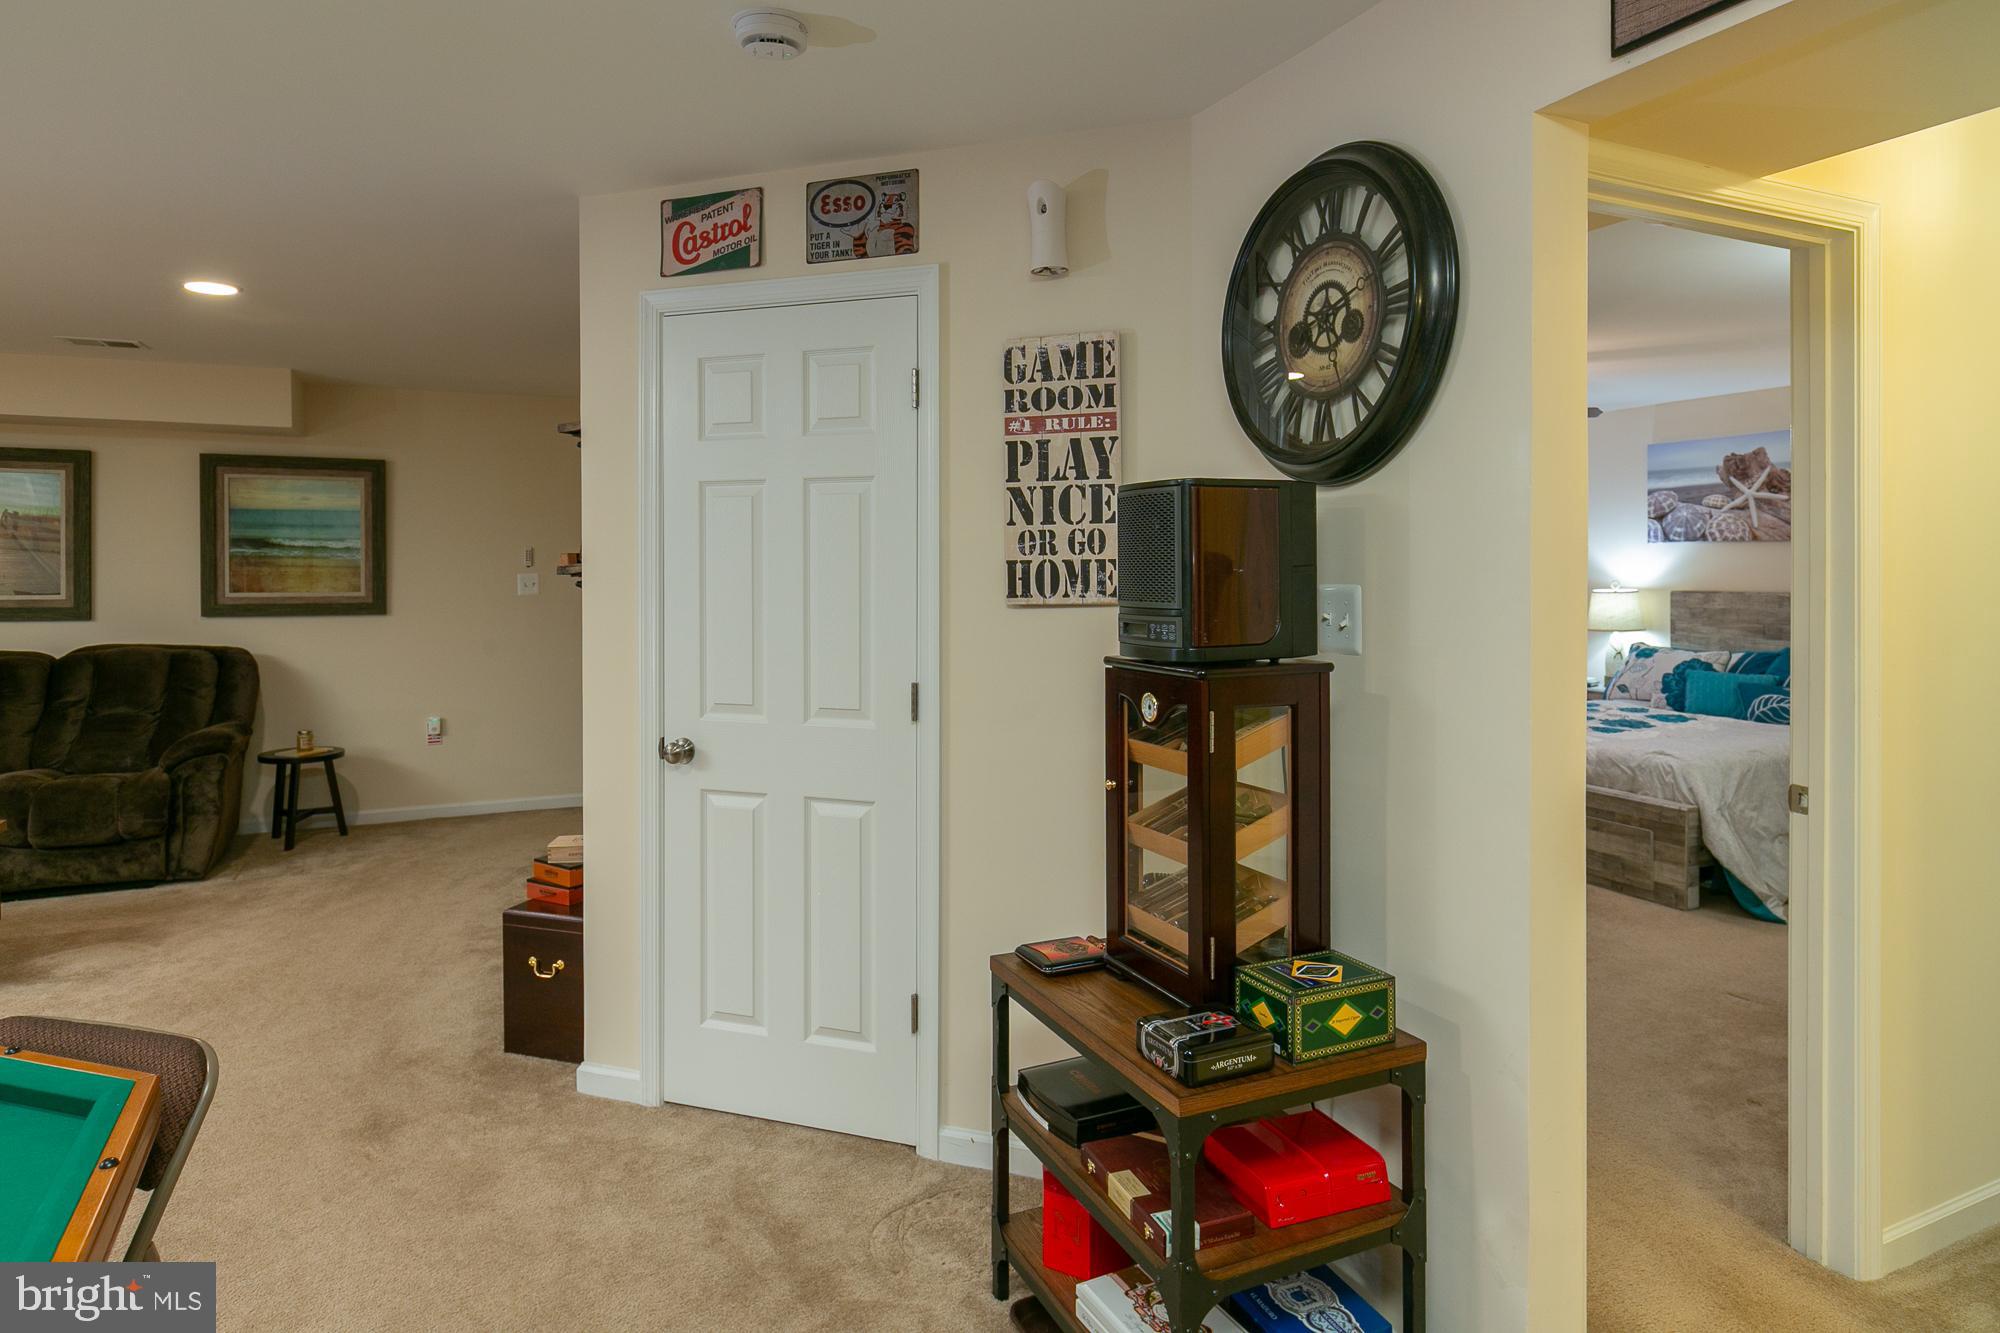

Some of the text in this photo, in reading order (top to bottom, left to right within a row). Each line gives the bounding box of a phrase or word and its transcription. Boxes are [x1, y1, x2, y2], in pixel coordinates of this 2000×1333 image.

[701, 201, 735, 223] PATENT
[672, 203, 752, 265] Castrol
[712, 234, 758, 258] MOTOR OIL
[810, 231, 831, 242] PUT A
[810, 240, 841, 252] TIGER IN
[810, 248, 853, 260] YOUR TANK!
[1003, 339, 1117, 385] GAME
[1003, 383, 1117, 414] ROOM
[1008, 415, 1111, 433] #1 RULE:
[1005, 436, 1119, 483] PLAY
[1006, 483, 1117, 526] NICE
[1017, 528, 1107, 557] OR GO
[1006, 559, 1118, 600] HOME
[1213, 1054, 1253, 1071] ARGENTUM
